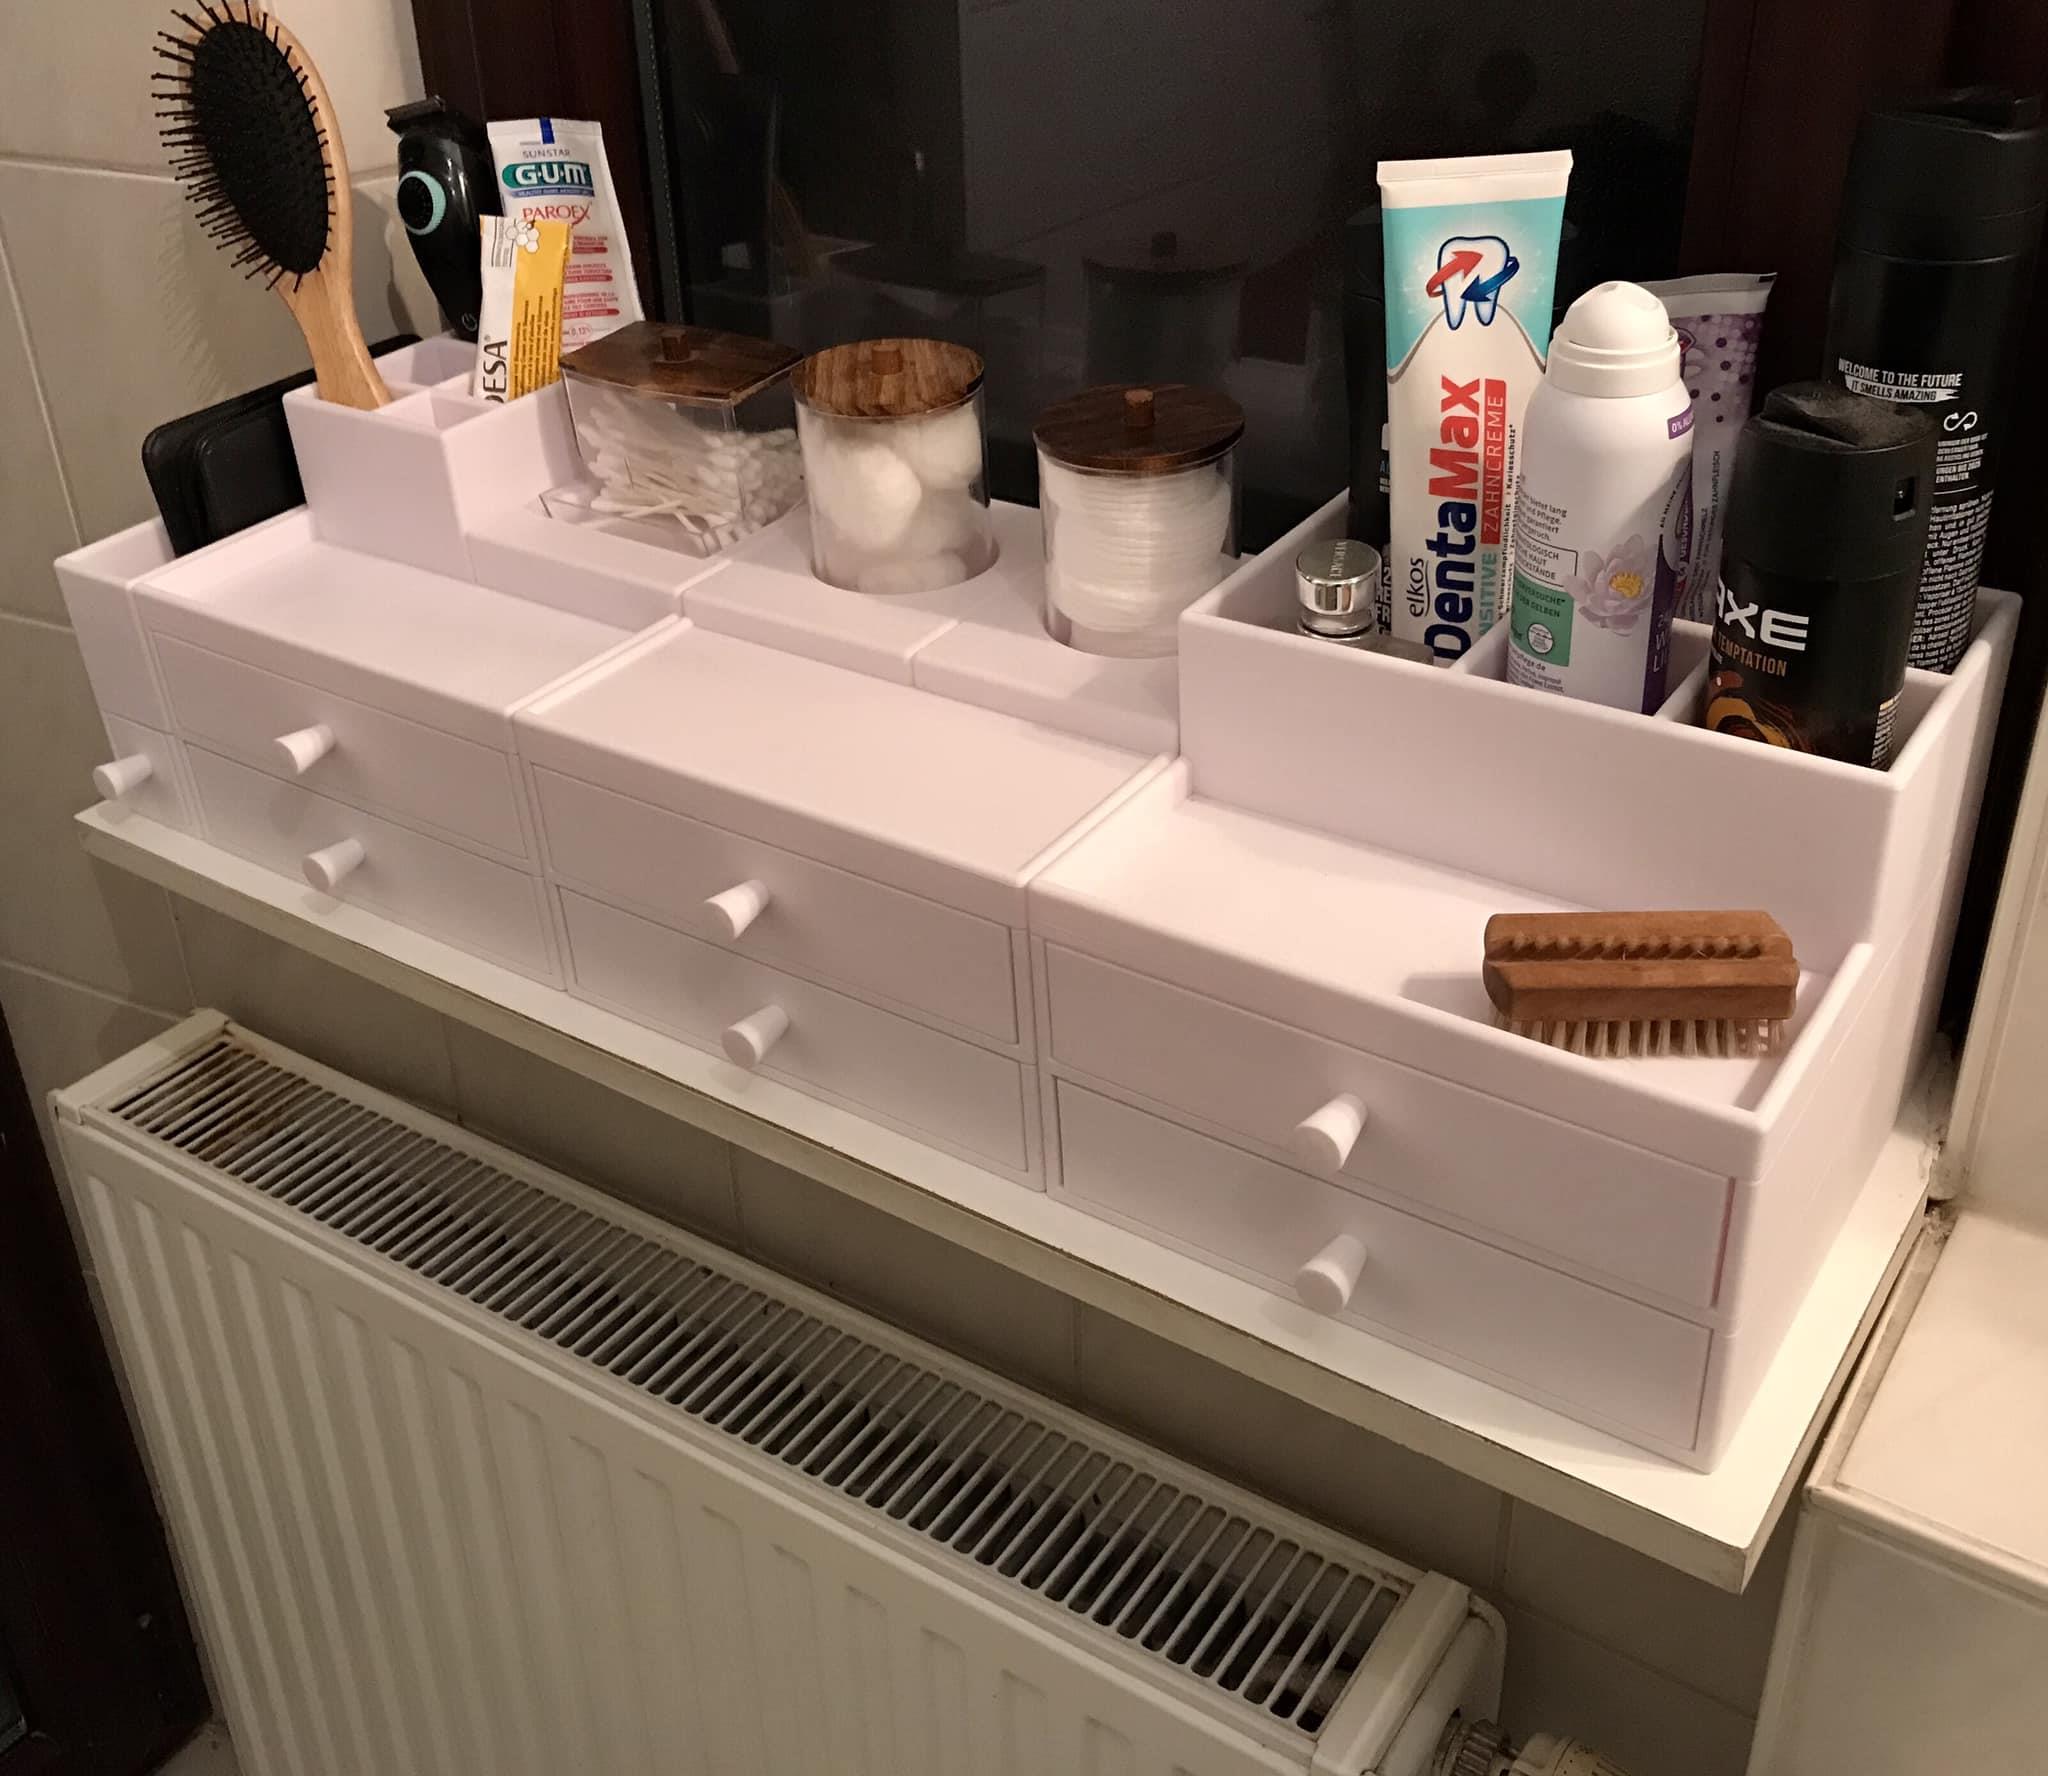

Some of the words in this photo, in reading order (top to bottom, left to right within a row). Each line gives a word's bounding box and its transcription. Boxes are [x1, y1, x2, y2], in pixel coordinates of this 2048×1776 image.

[522, 148, 571, 159] SUNSTAR
[522, 203, 591, 226] PAROEX
[1838, 358, 1880, 381] WELCOME
[1882, 370, 1895, 384] TO
[1897, 372, 1919, 387] THE
[1921, 373, 1963, 388] FUTURE
[1861, 382, 1893, 398] SMELLS
[1894, 388, 1937, 401] AMAZING
[1484, 395, 1504, 533] ZAHNCREME
[1424, 374, 1480, 660] DentaMax
[1549, 504, 1567, 518] lang
[1406, 557, 1425, 618] elkos
[1479, 552, 1497, 635] NSITIVE
[1718, 631, 1788, 678] TEMPTATION
